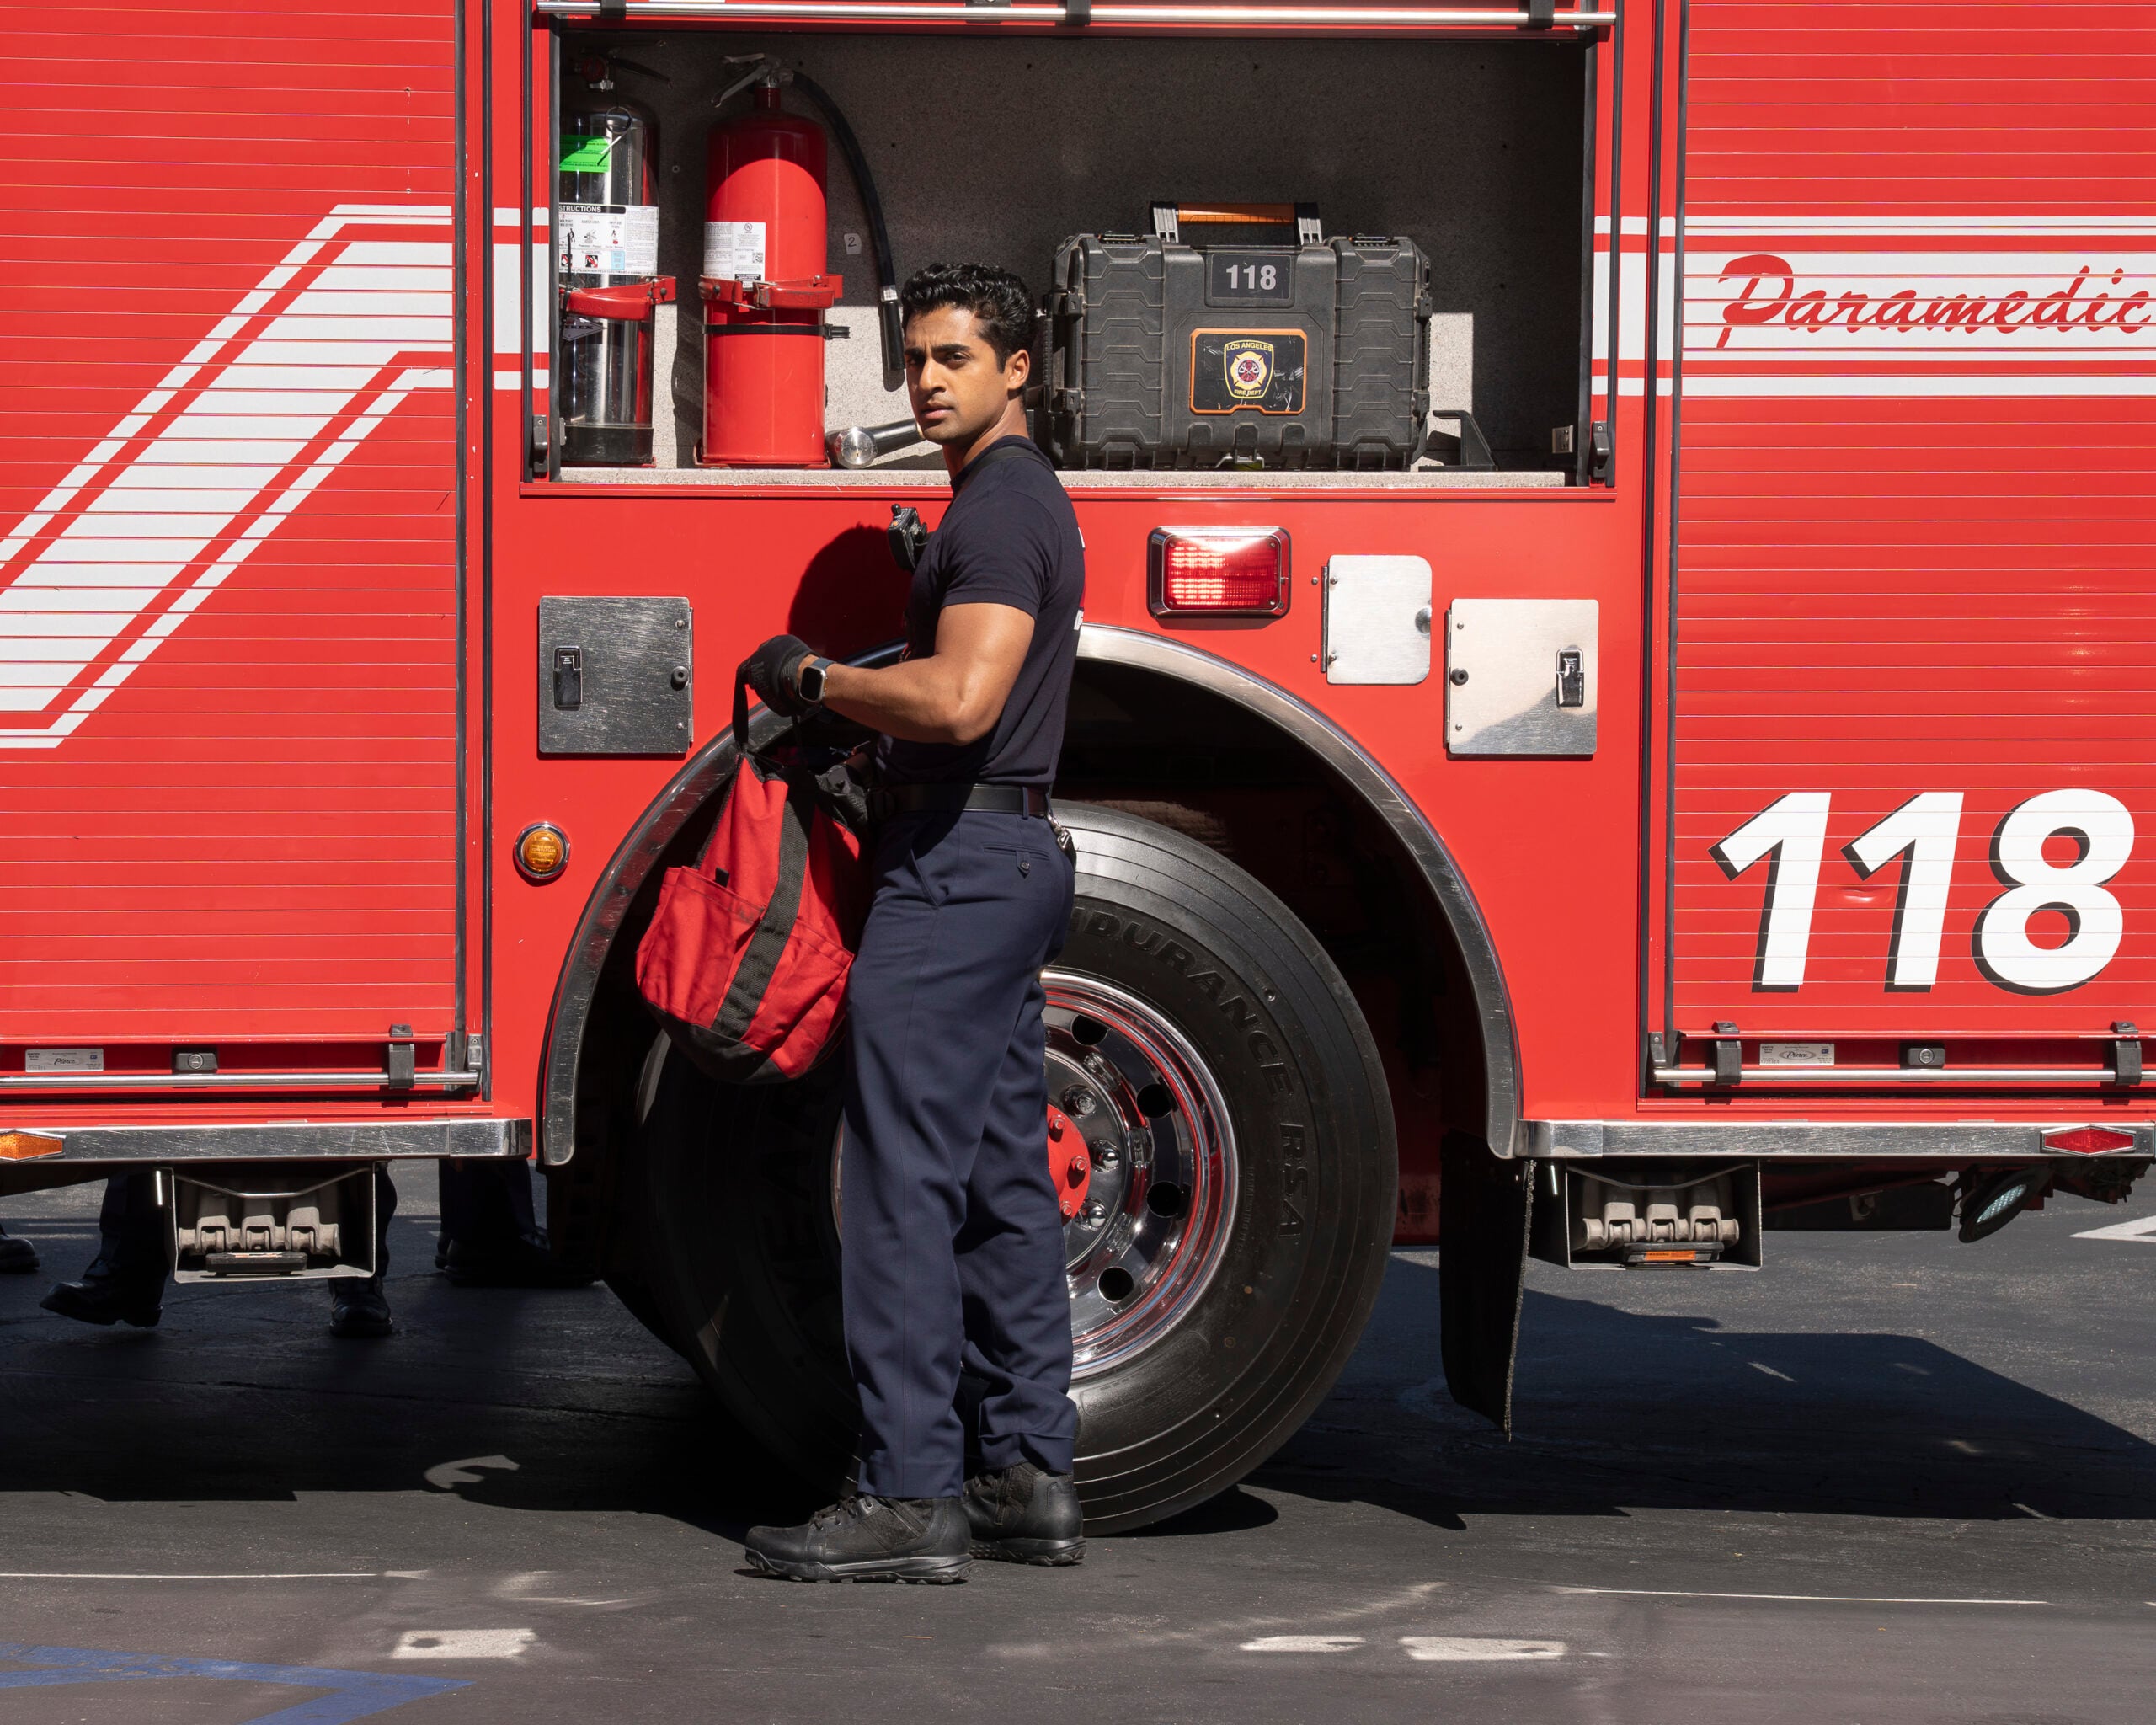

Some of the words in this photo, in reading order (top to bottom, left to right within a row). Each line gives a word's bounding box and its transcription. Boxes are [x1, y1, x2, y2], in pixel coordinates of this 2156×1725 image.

[847, 237, 857, 248] 2
[1225, 264, 1277, 290] 118
[1716, 254, 2151, 349] Paramedic
[1226, 343, 1241, 352] LOS
[1241, 342, 1273, 352] ANGELES
[1708, 788, 2136, 996] 118
[1278, 1122, 1309, 1240] RSA
